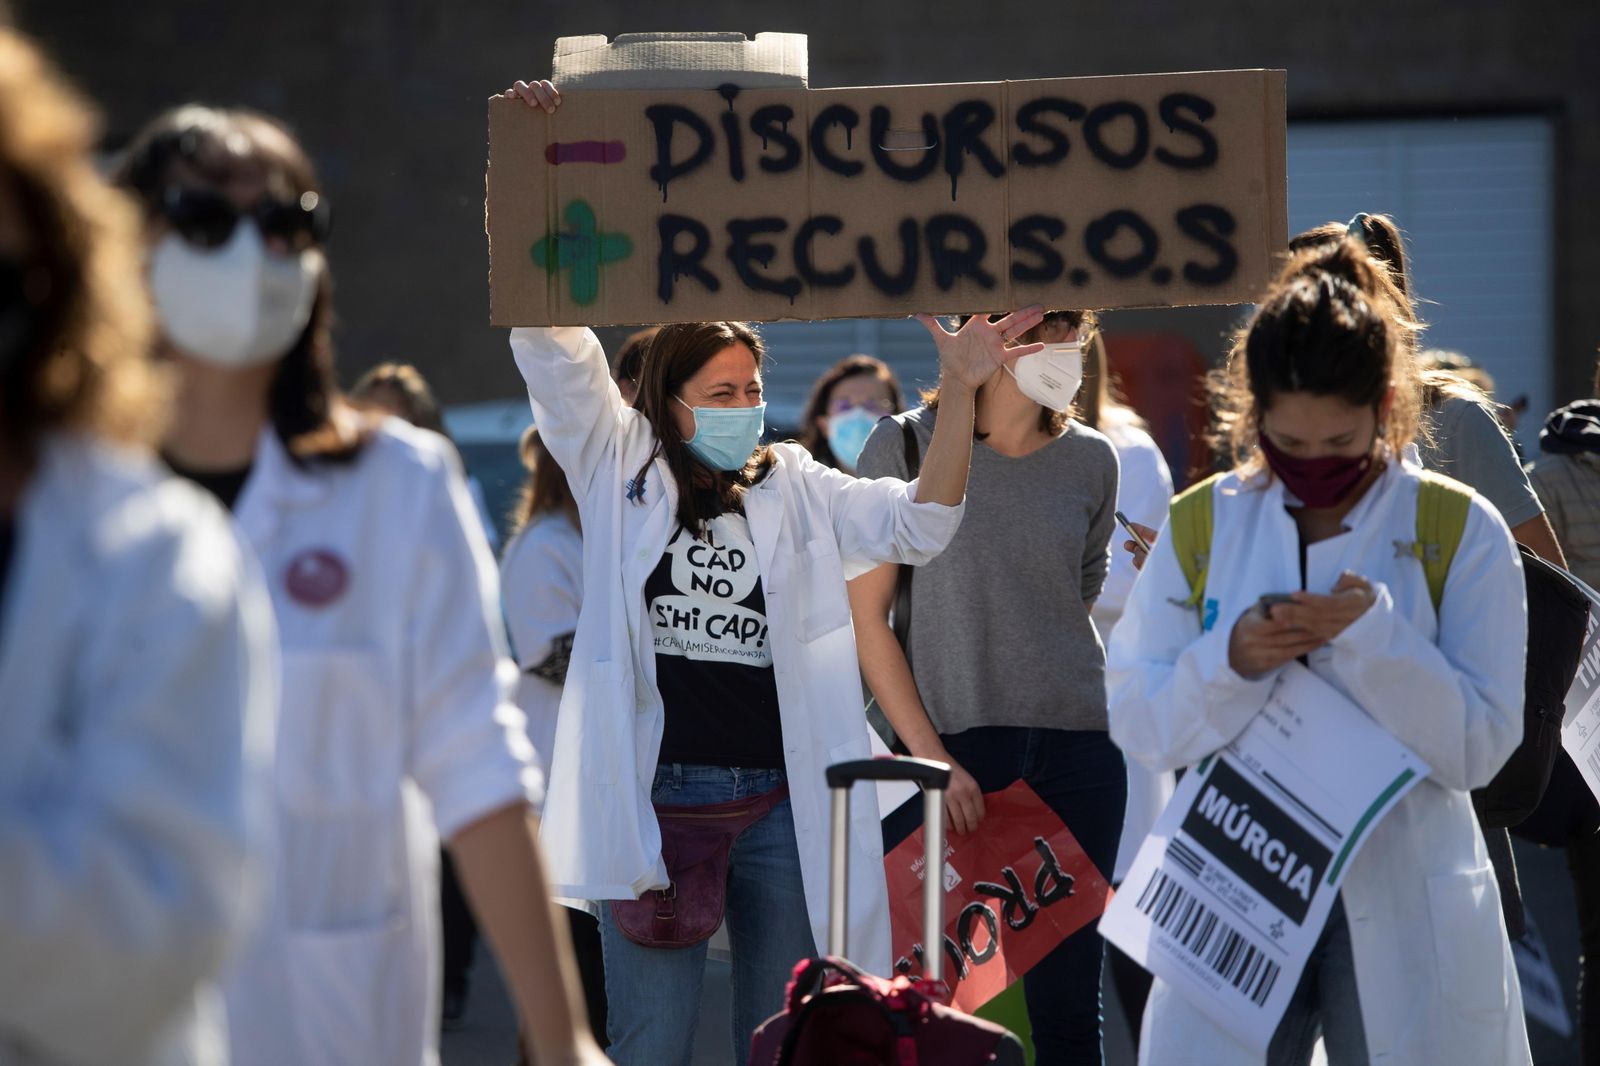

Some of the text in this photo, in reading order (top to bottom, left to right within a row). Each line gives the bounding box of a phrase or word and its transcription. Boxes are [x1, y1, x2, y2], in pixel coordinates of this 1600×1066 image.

[656, 202, 1239, 304] RECURS.O.S
[690, 571, 734, 598] NO
[705, 614, 769, 648] CAP!
[1196, 785, 1314, 901] MÚRCIA
